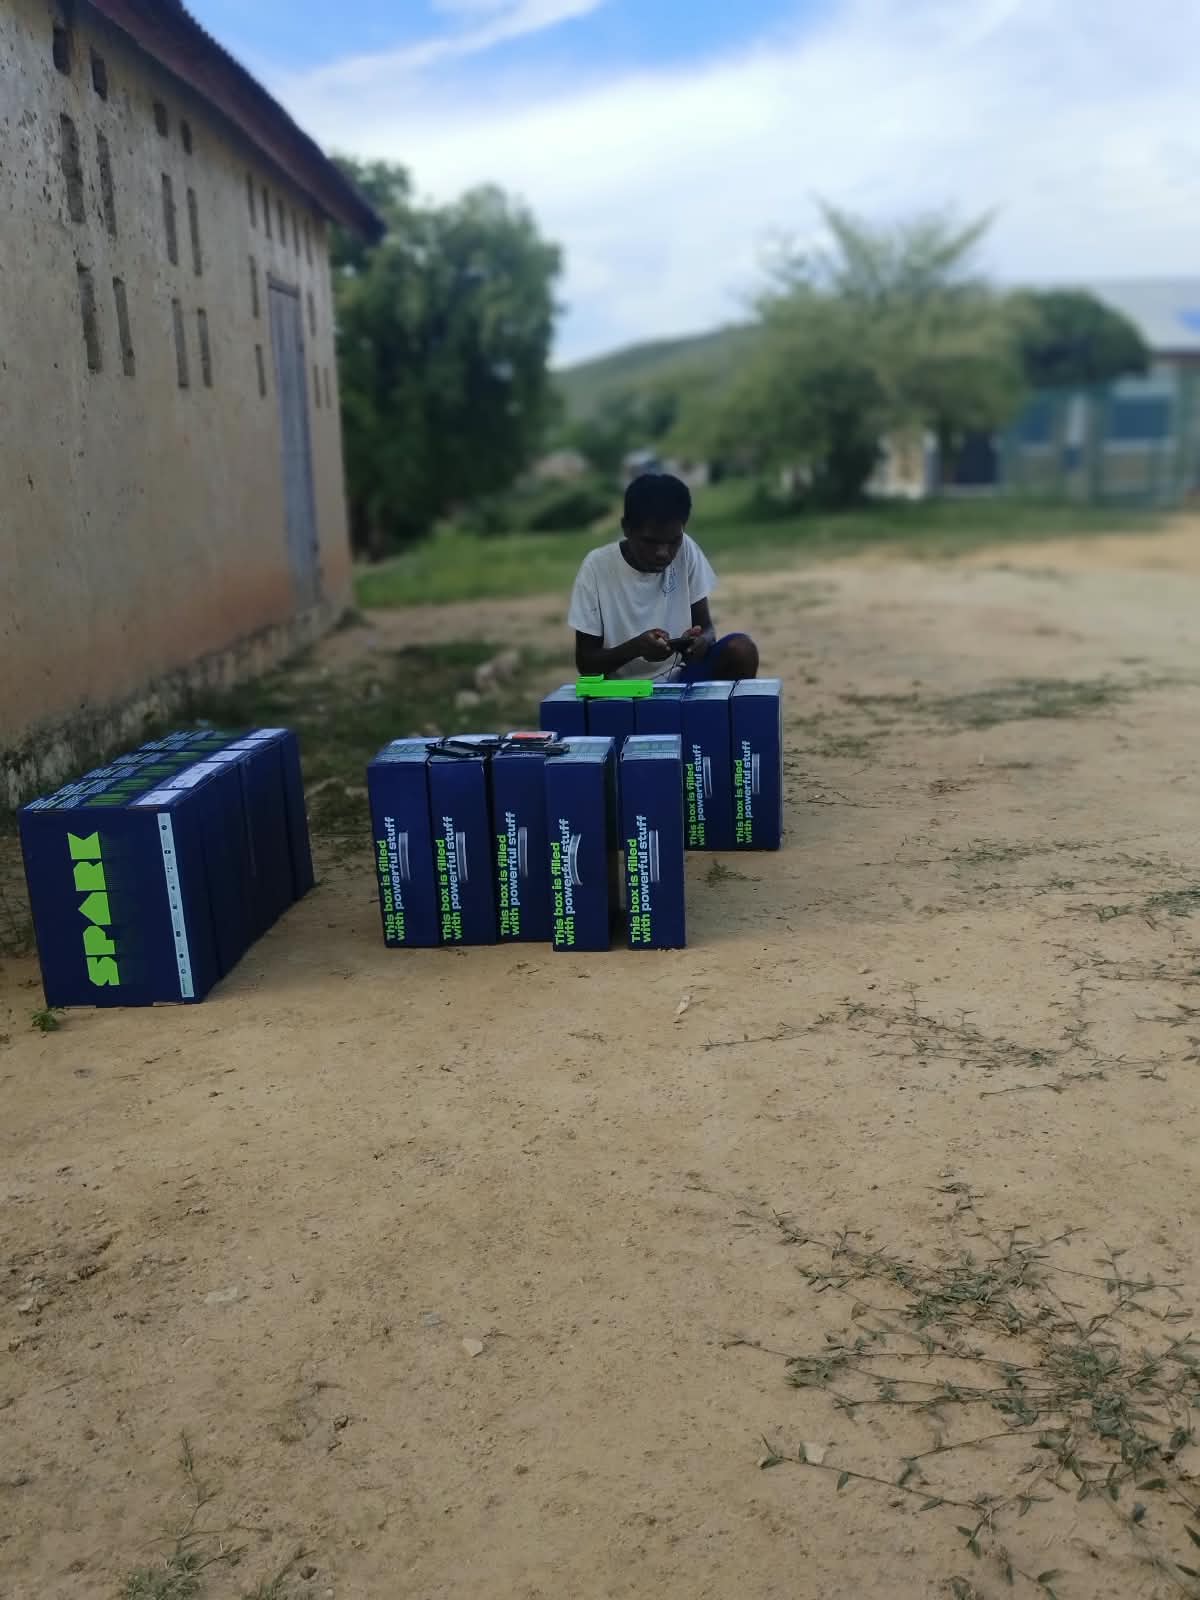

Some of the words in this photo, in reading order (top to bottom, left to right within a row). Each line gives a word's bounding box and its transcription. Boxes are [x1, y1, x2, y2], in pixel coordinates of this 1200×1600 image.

[692, 744, 702, 772] stuff
[742, 740, 751, 768] stuff
[686, 763, 695, 790] filled
[734, 759, 743, 786] filled
[688, 792, 696, 801] is
[695, 774, 706, 821] powerful
[734, 788, 743, 798] is
[743, 770, 754, 818] powerful
[688, 803, 696, 822] box
[736, 800, 744, 819] box
[384, 816, 397, 850] stuff
[442, 816, 455, 850] stuff
[505, 811, 516, 845] stuff
[559, 818, 570, 853] stuff
[636, 815, 648, 850] stuff
[688, 824, 697, 846] This
[697, 822, 705, 846] with
[735, 821, 744, 844] This
[744, 820, 752, 844] with
[376, 840, 389, 873] filled
[435, 839, 447, 872] filled
[497, 834, 507, 868] filled
[550, 842, 561, 875] filled
[627, 839, 638, 872] filled
[380, 874, 390, 886] is
[388, 852, 405, 910] powerful
[439, 874, 448, 886] is
[446, 851, 461, 910] powerful
[498, 869, 508, 881] is
[507, 847, 520, 906] powerful
[552, 878, 562, 890] is
[561, 856, 576, 914] powerful
[628, 874, 639, 886] is
[638, 851, 652, 911] powerful
[67, 831, 120, 986] SPARK
[384, 888, 393, 911] box
[441, 888, 450, 911] box
[500, 884, 509, 907] box
[554, 892, 563, 916] box
[630, 888, 640, 913] box
[385, 914, 395, 940] This
[395, 912, 405, 940] with
[442, 914, 452, 940] This
[451, 912, 462, 939] with
[500, 909, 510, 936] This
[510, 908, 519, 935] with
[554, 918, 565, 945] This
[564, 917, 575, 945] with
[630, 915, 640, 943] This
[641, 913, 651, 942] with
